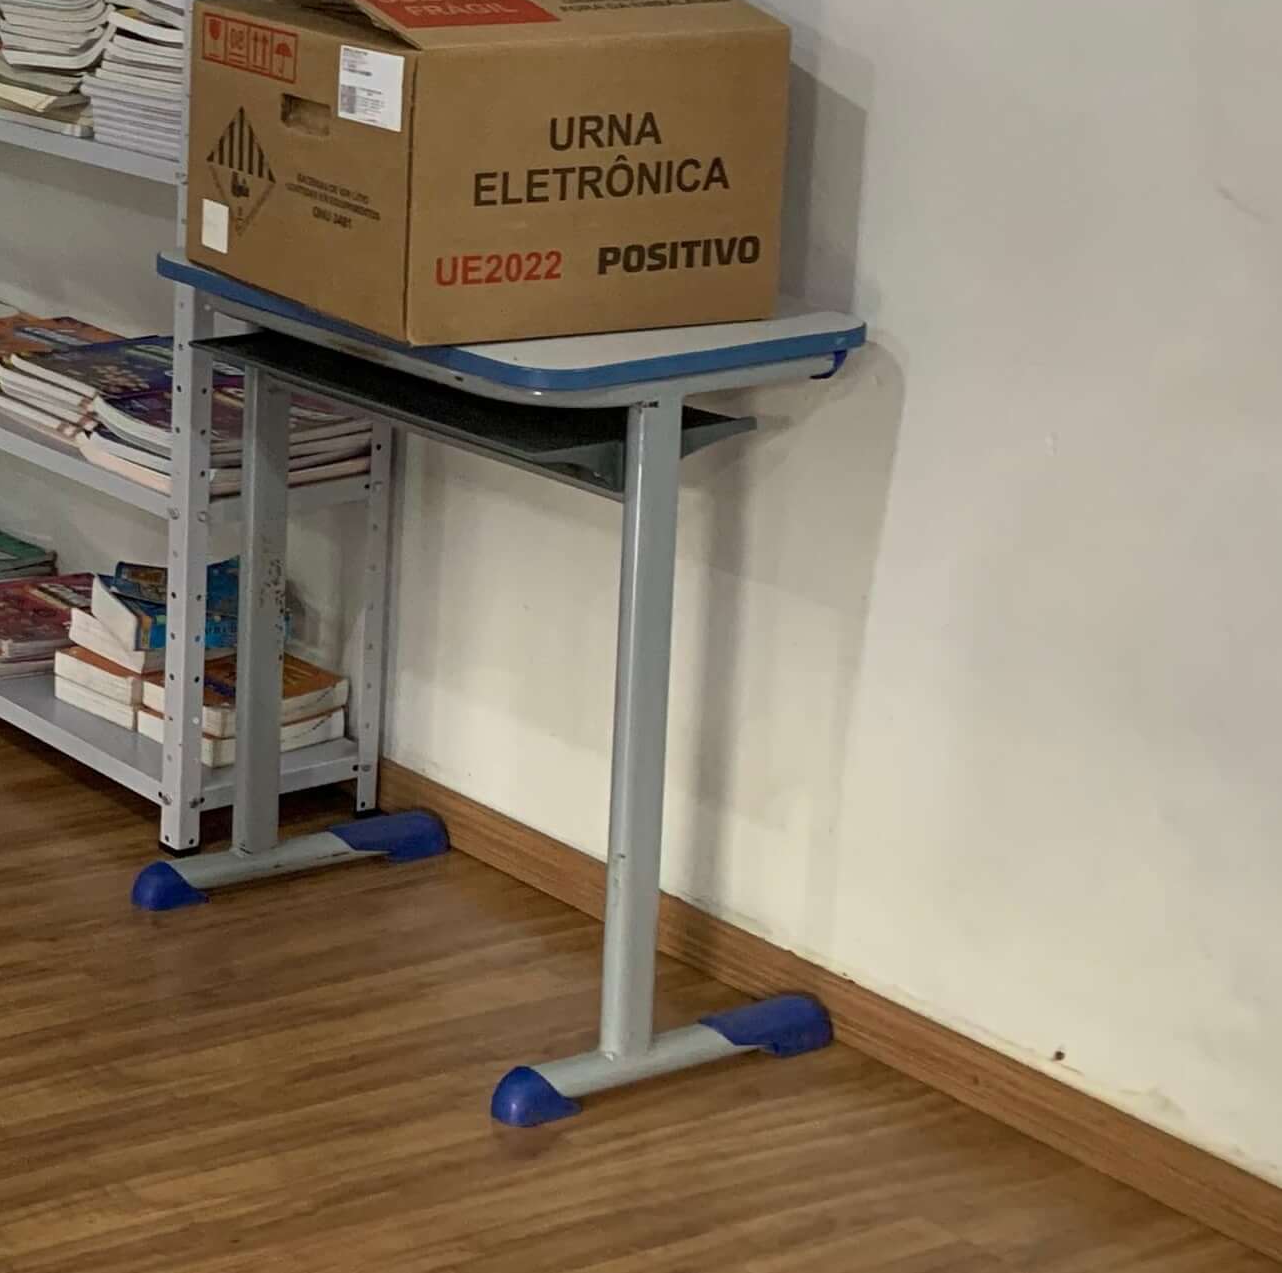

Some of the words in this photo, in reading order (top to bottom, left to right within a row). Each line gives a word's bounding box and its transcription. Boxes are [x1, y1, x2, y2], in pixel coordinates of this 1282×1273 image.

[550, 112, 661, 151] URNA
[474, 154, 730, 207] ELETRÔNICA
[435, 250, 562, 287] UE2022
[597, 235, 761, 276] POSITIVO
